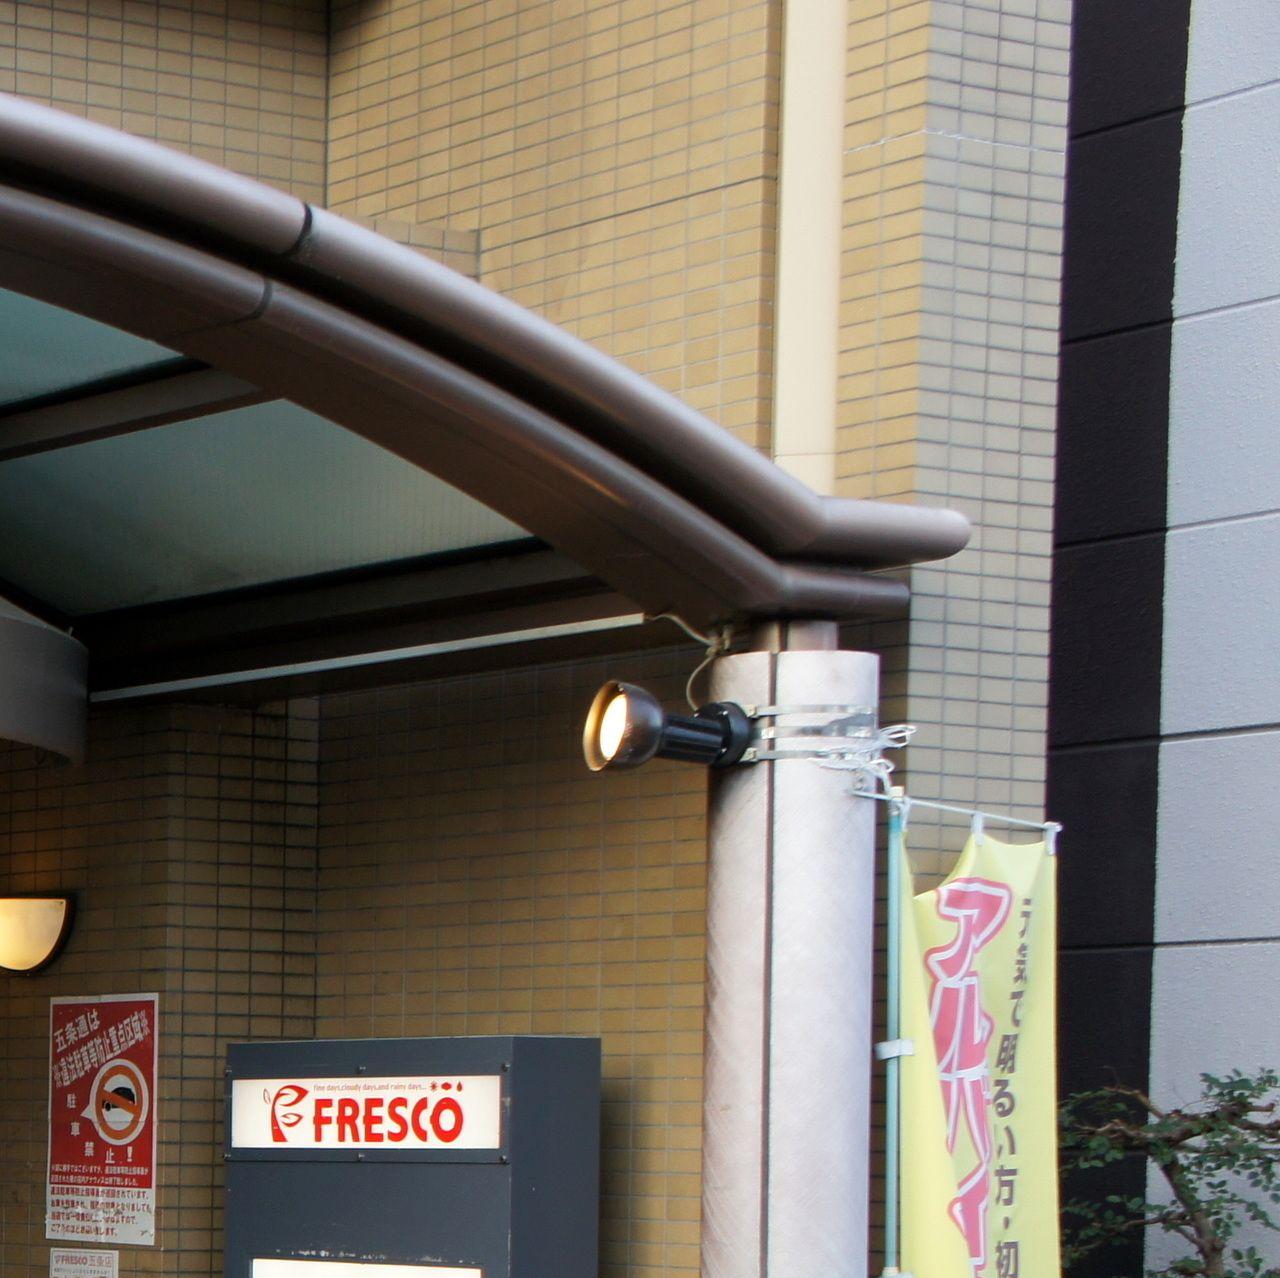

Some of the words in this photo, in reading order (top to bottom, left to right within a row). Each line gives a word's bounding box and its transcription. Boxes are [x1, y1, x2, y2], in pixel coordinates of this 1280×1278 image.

[53, 1008, 101, 1053] 五条通は
[313, 1097, 463, 1143] FRESCO
